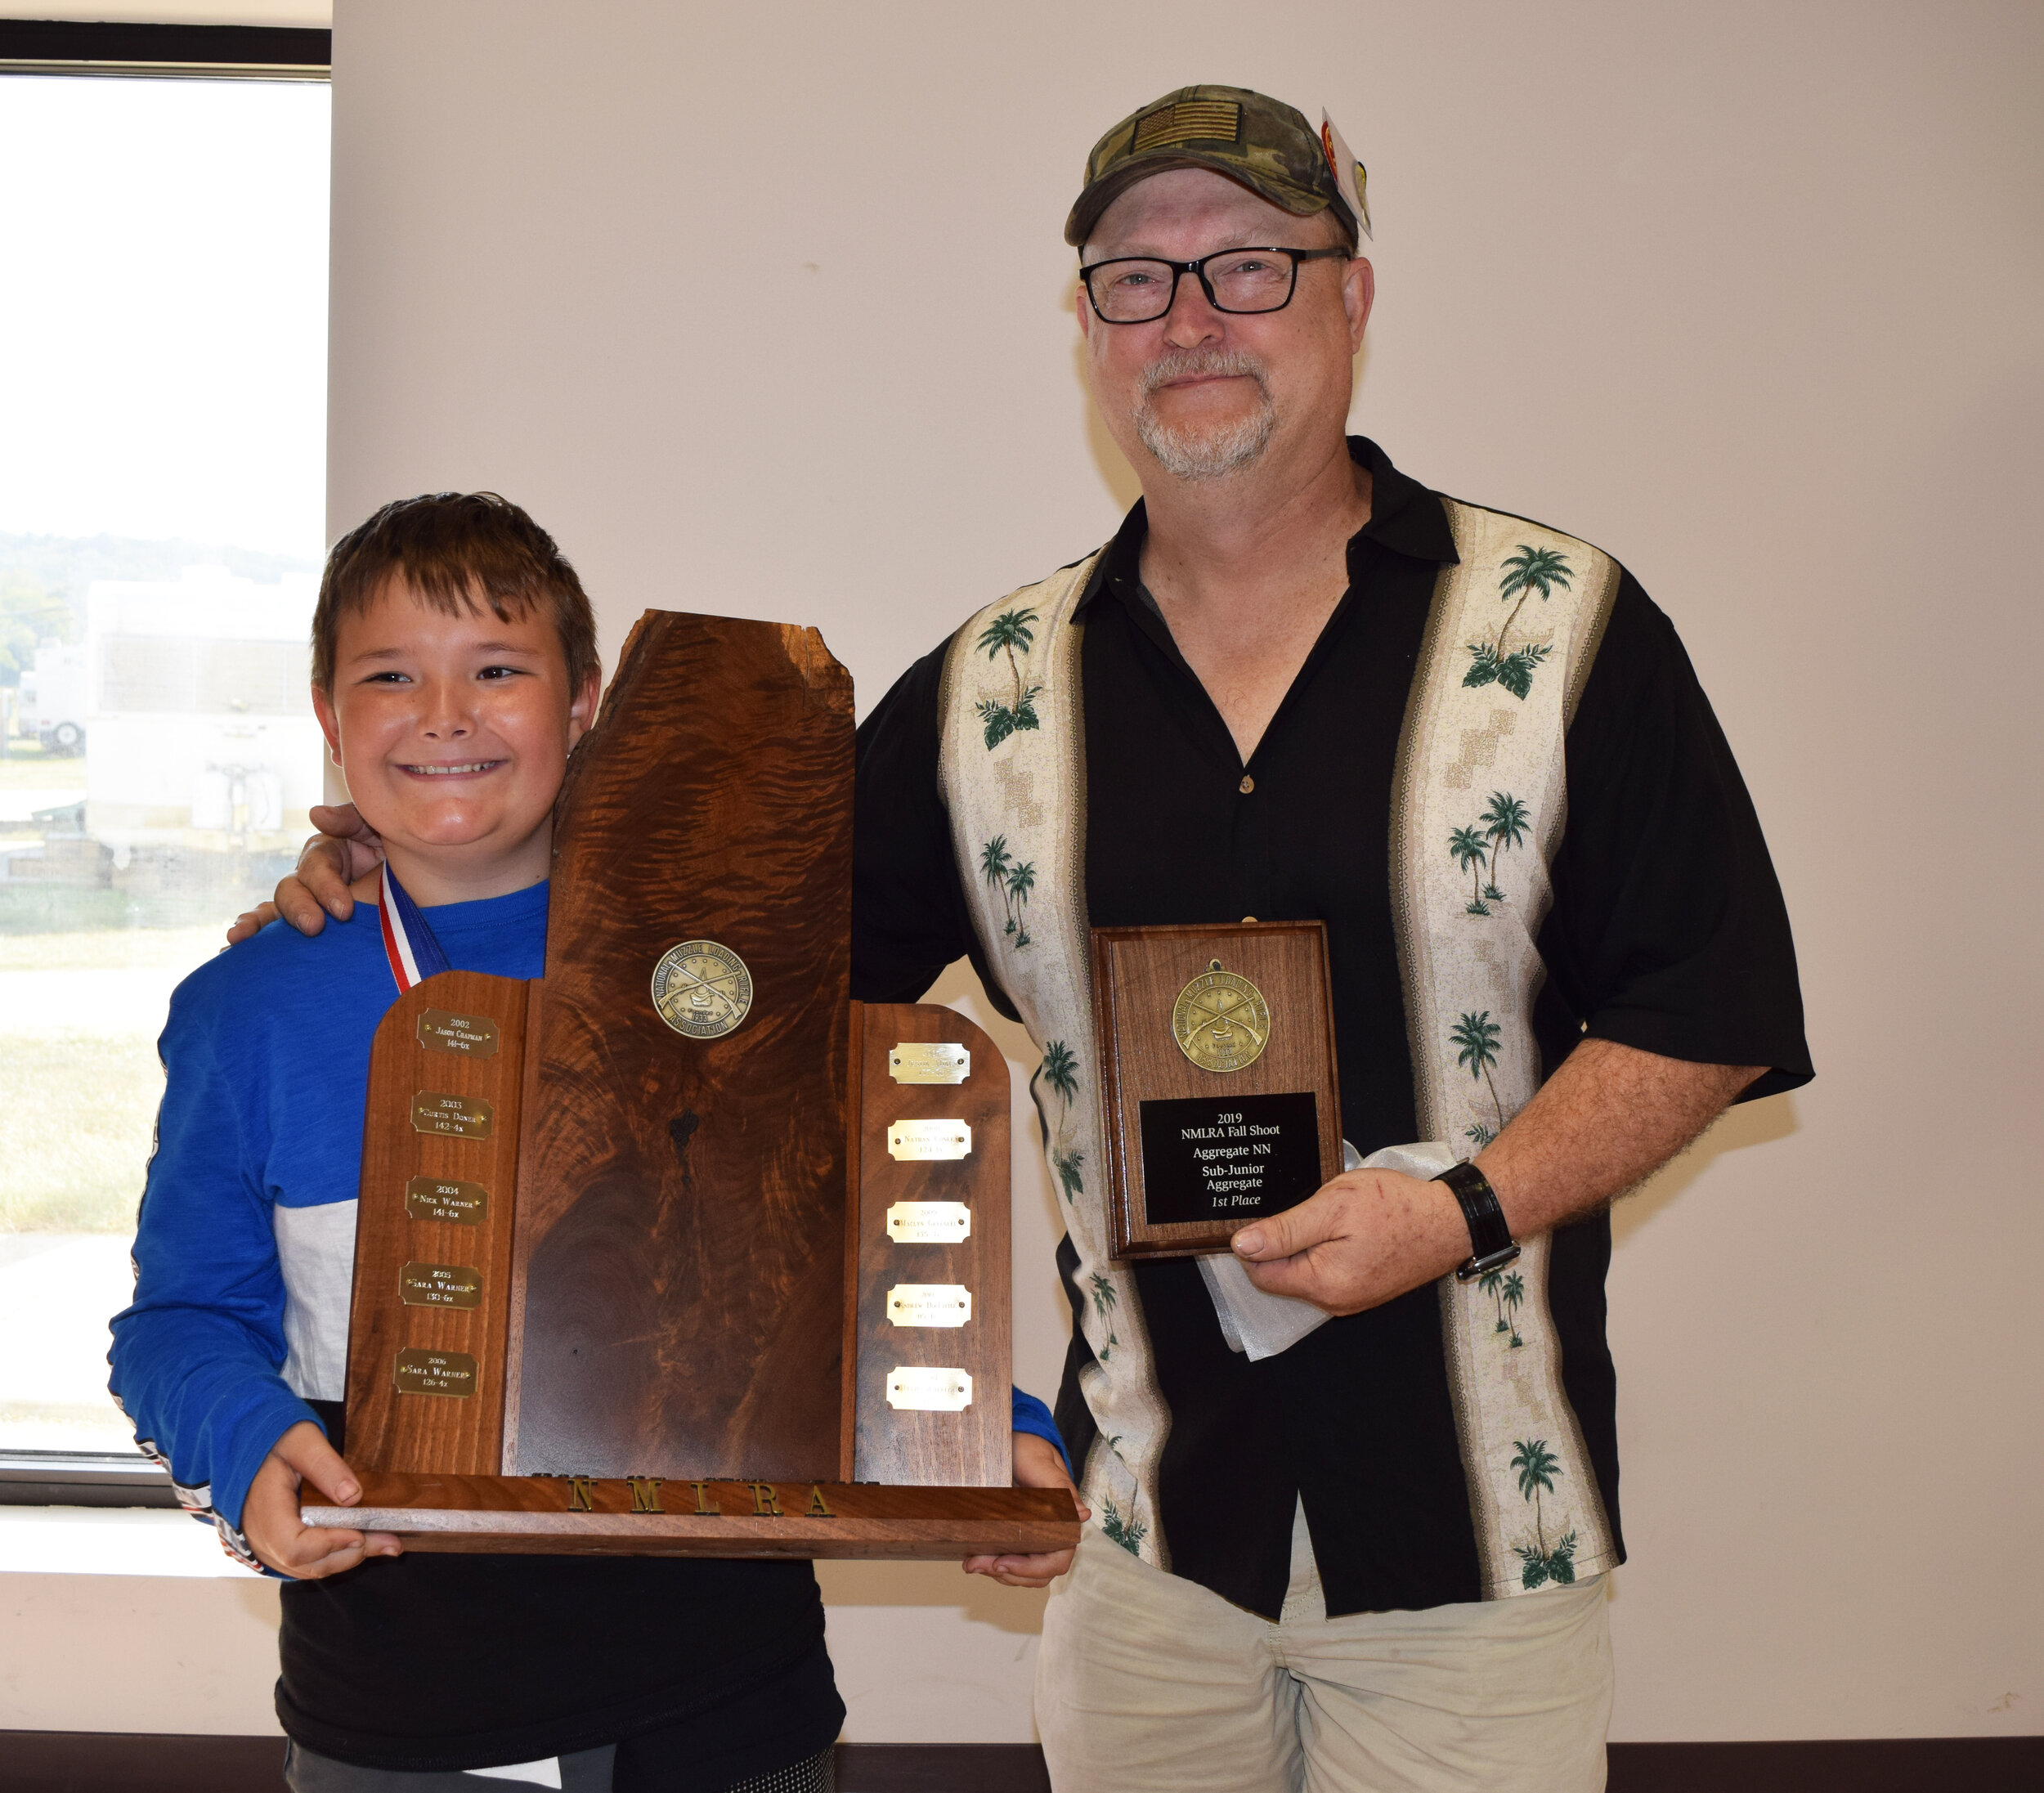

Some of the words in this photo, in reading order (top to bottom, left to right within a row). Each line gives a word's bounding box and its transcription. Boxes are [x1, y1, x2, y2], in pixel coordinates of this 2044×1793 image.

[655, 964, 672, 997] NATIONAL
[670, 944, 703, 962] MUZZLE
[708, 945, 741, 970] LOADING
[737, 975, 750, 1005] RIFLE
[450, 1019, 470, 1029] 2002
[669, 1014, 728, 1035] ASSOCIATION
[692, 1013, 707, 1023] 1933
[440, 1099, 462, 1109] 2003
[1217, 1113, 1243, 1124] 2019
[435, 1122, 464, 1132] 142-4x
[1181, 1127, 1225, 1140] NMLRA
[1228, 1126, 1247, 1136] Fall
[1249, 1125, 1280, 1136] Shoot
[1193, 1146, 1249, 1160] Aggregate
[1253, 1144, 1271, 1154] NN
[1202, 1163, 1265, 1177] Sub-Junior
[436, 1185, 459, 1195] 2004
[1207, 1178, 1263, 1192] Aggregate
[1212, 1196, 1228, 1208] 1st
[1230, 1195, 1262, 1206] Place
